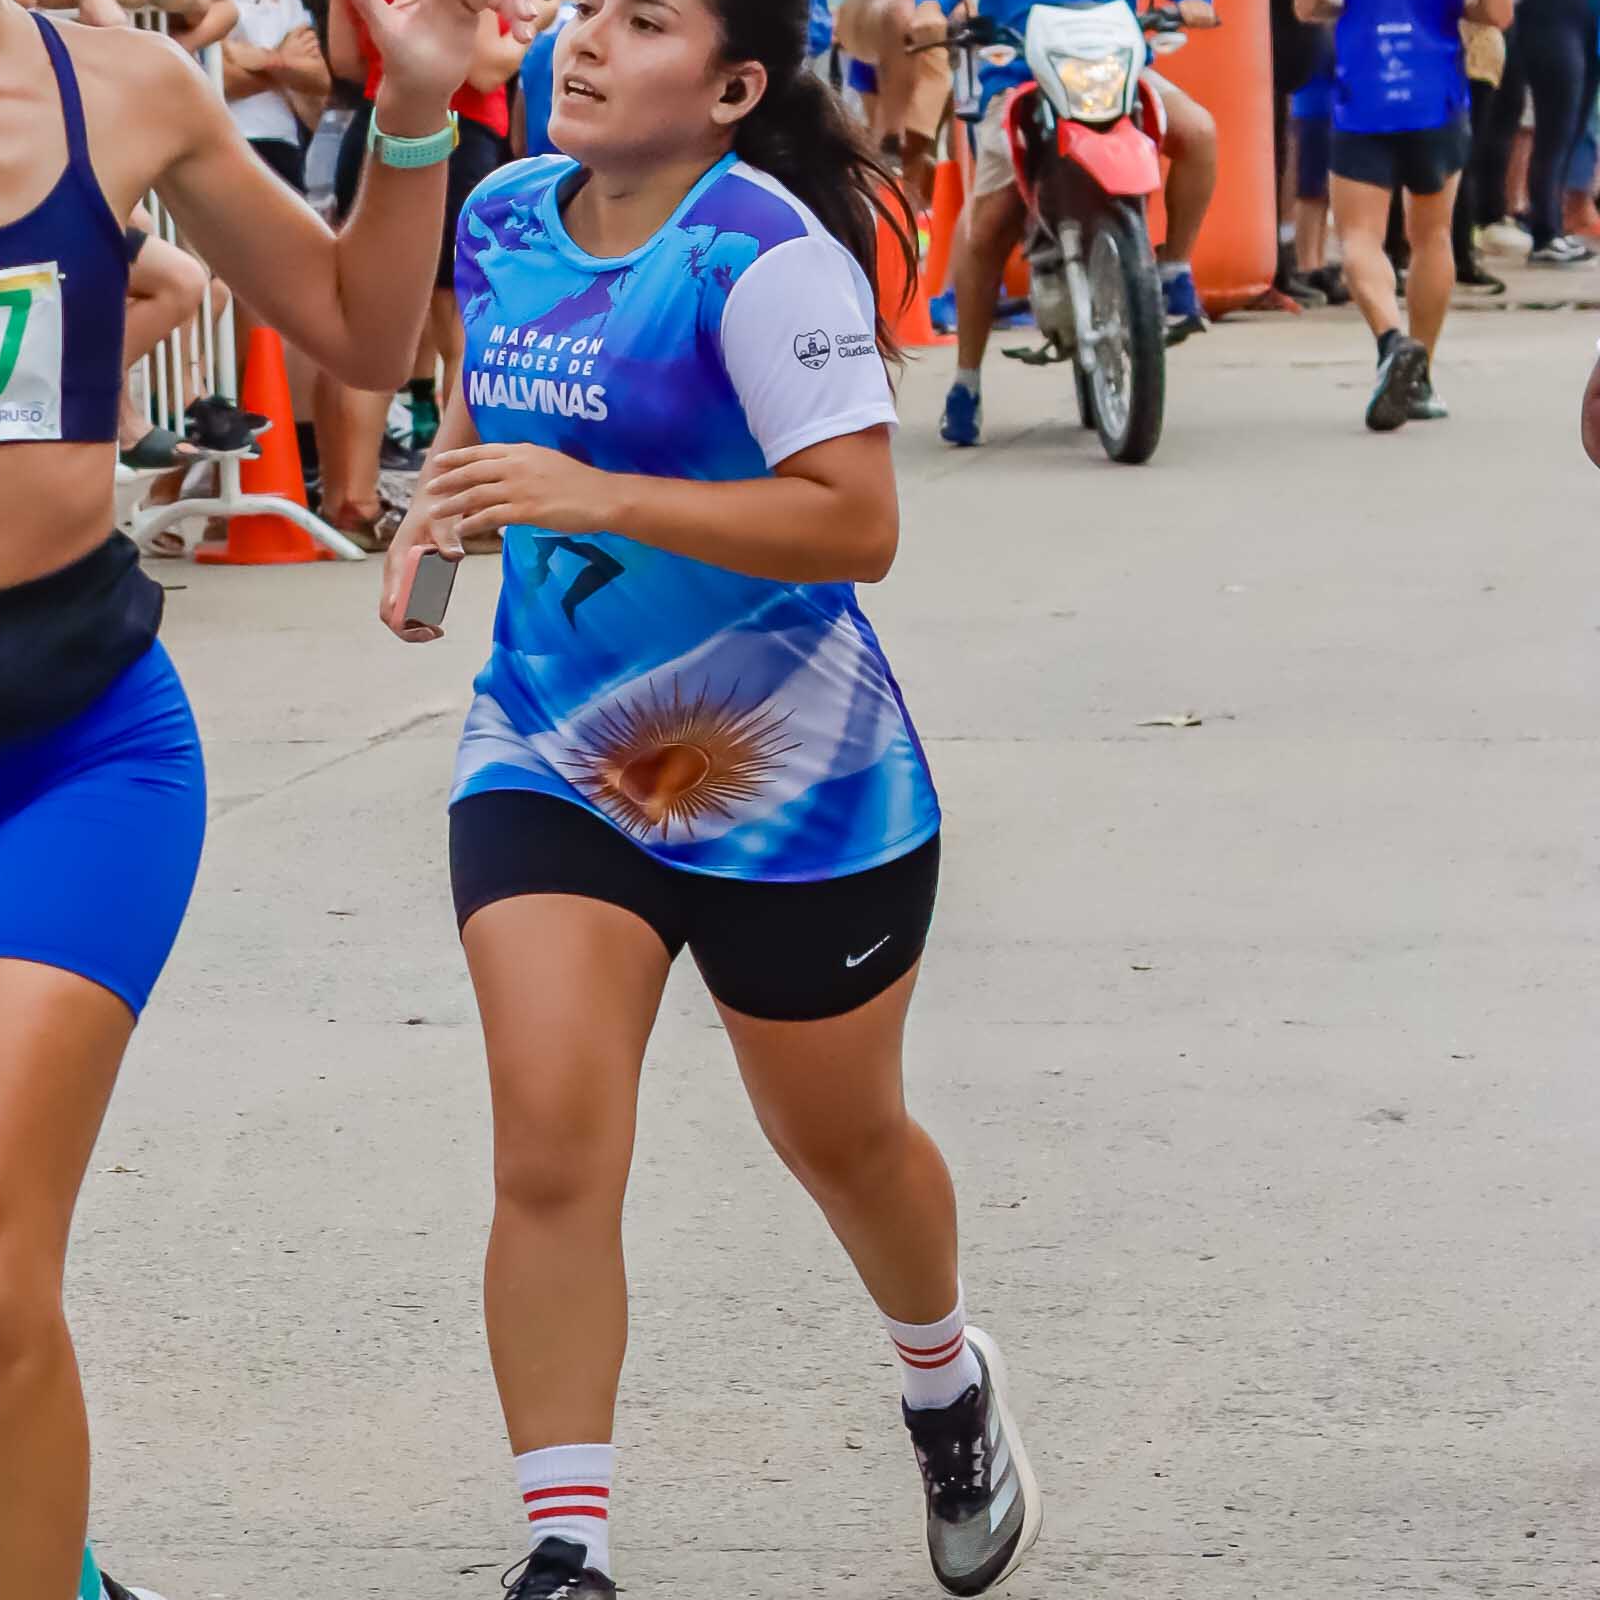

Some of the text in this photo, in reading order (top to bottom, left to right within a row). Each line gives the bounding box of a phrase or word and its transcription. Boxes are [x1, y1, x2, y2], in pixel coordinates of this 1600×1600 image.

[489, 324, 605, 355] MARATÓN
[483, 347, 595, 376] HÉROES DE
[469, 370, 608, 421] MALVINAS
